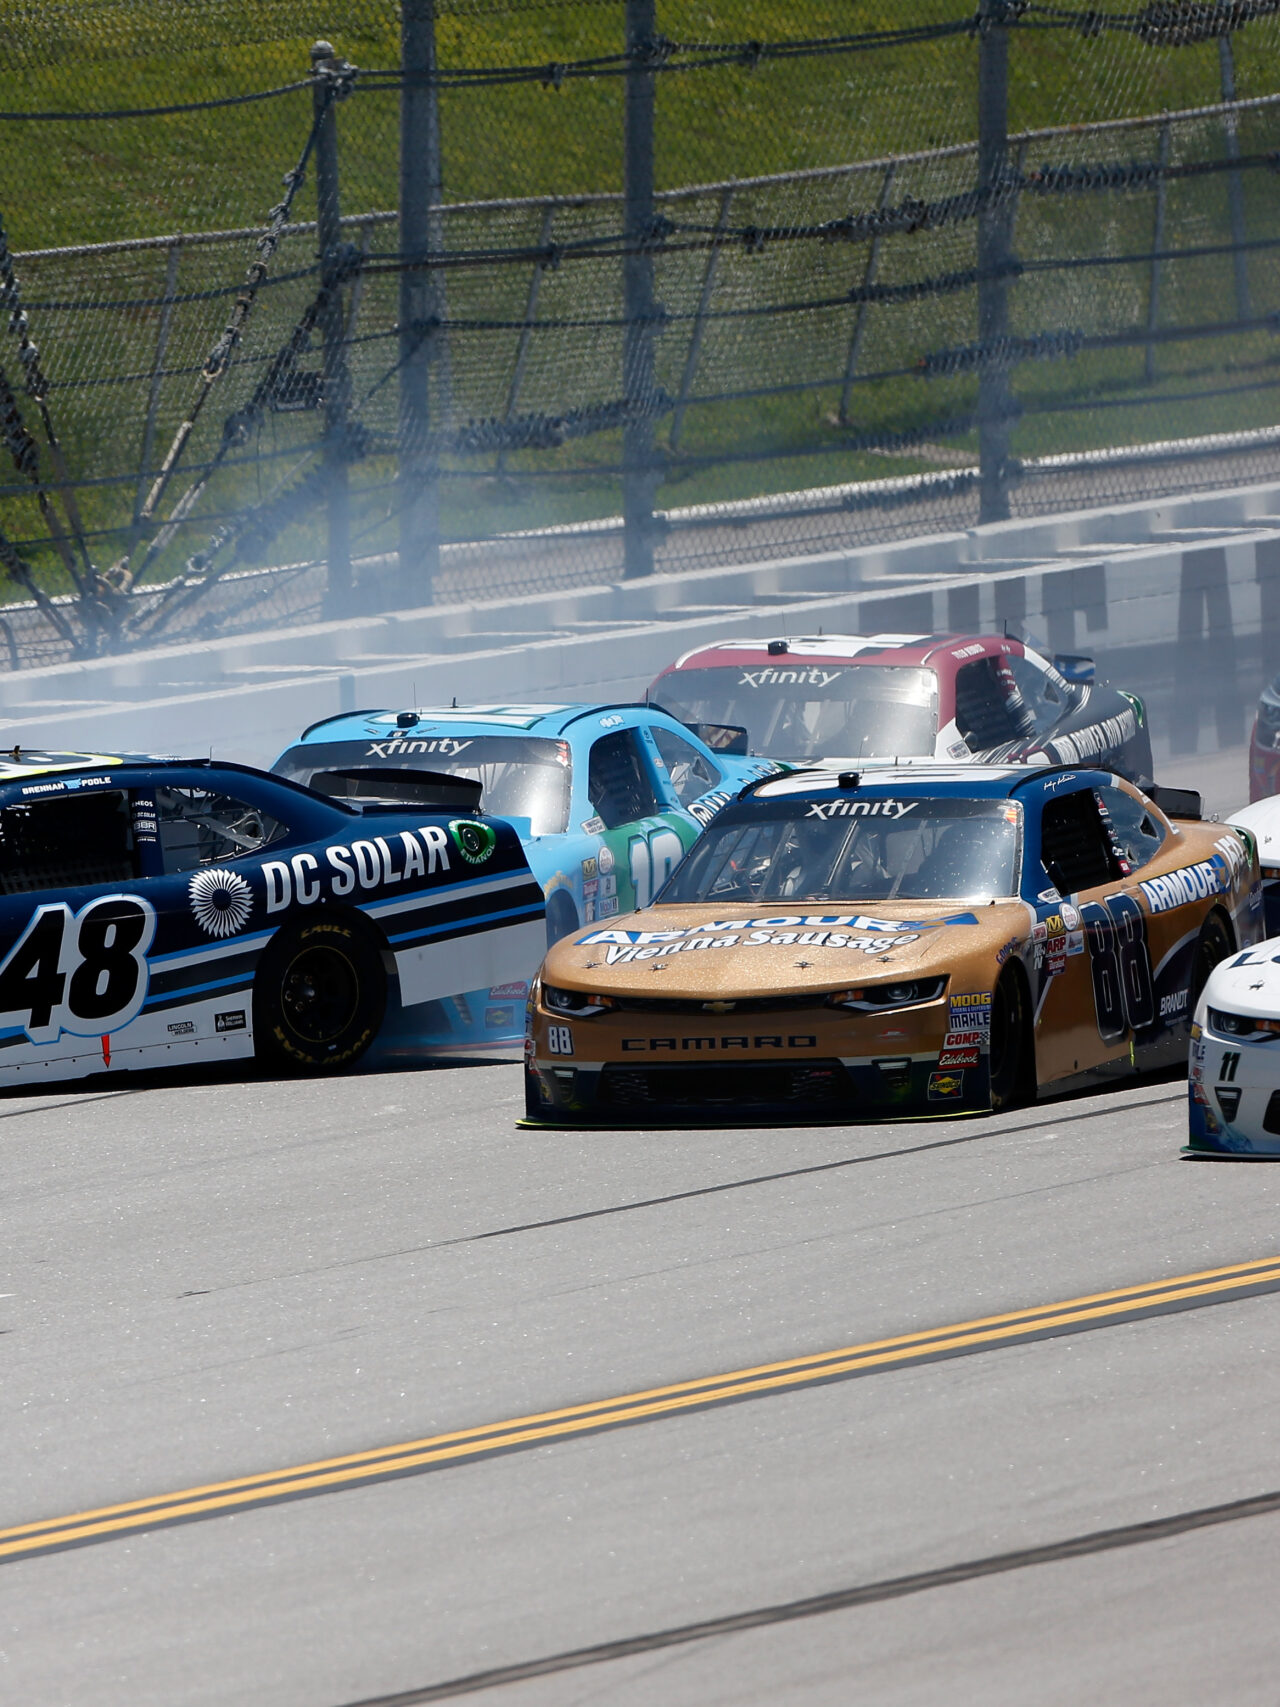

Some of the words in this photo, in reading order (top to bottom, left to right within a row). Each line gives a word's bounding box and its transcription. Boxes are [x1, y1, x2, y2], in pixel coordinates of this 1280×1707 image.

[738, 668, 842, 688] xfinity
[366, 738, 473, 759] xfinity
[22, 783, 64, 795] BRENNAN
[81, 777, 111, 787] POOLE
[804, 799, 919, 820] xfinity
[460, 844, 495, 864] ETHANOL
[260, 853, 320, 914] DC
[325, 825, 450, 896] SOLAR
[1139, 861, 1220, 914] ARMOUR
[580, 915, 903, 946] ARMOUR
[605, 931, 740, 966] Vienna
[742, 929, 920, 954] Sausage
[1047, 936, 1067, 953] ARP
[1077, 891, 1154, 1041] 88
[950, 993, 991, 1008] MOOG
[1159, 990, 1188, 1017] BRANDT
[168, 1021, 192, 1031] LINCOLN
[950, 1012, 990, 1029] MAHLE
[547, 1025, 574, 1055] 88
[621, 1035, 817, 1052] CAMARO
[946, 1031, 980, 1046] COMP
[939, 1052, 978, 1066] Edelbrock
[1219, 1051, 1241, 1082] 11
